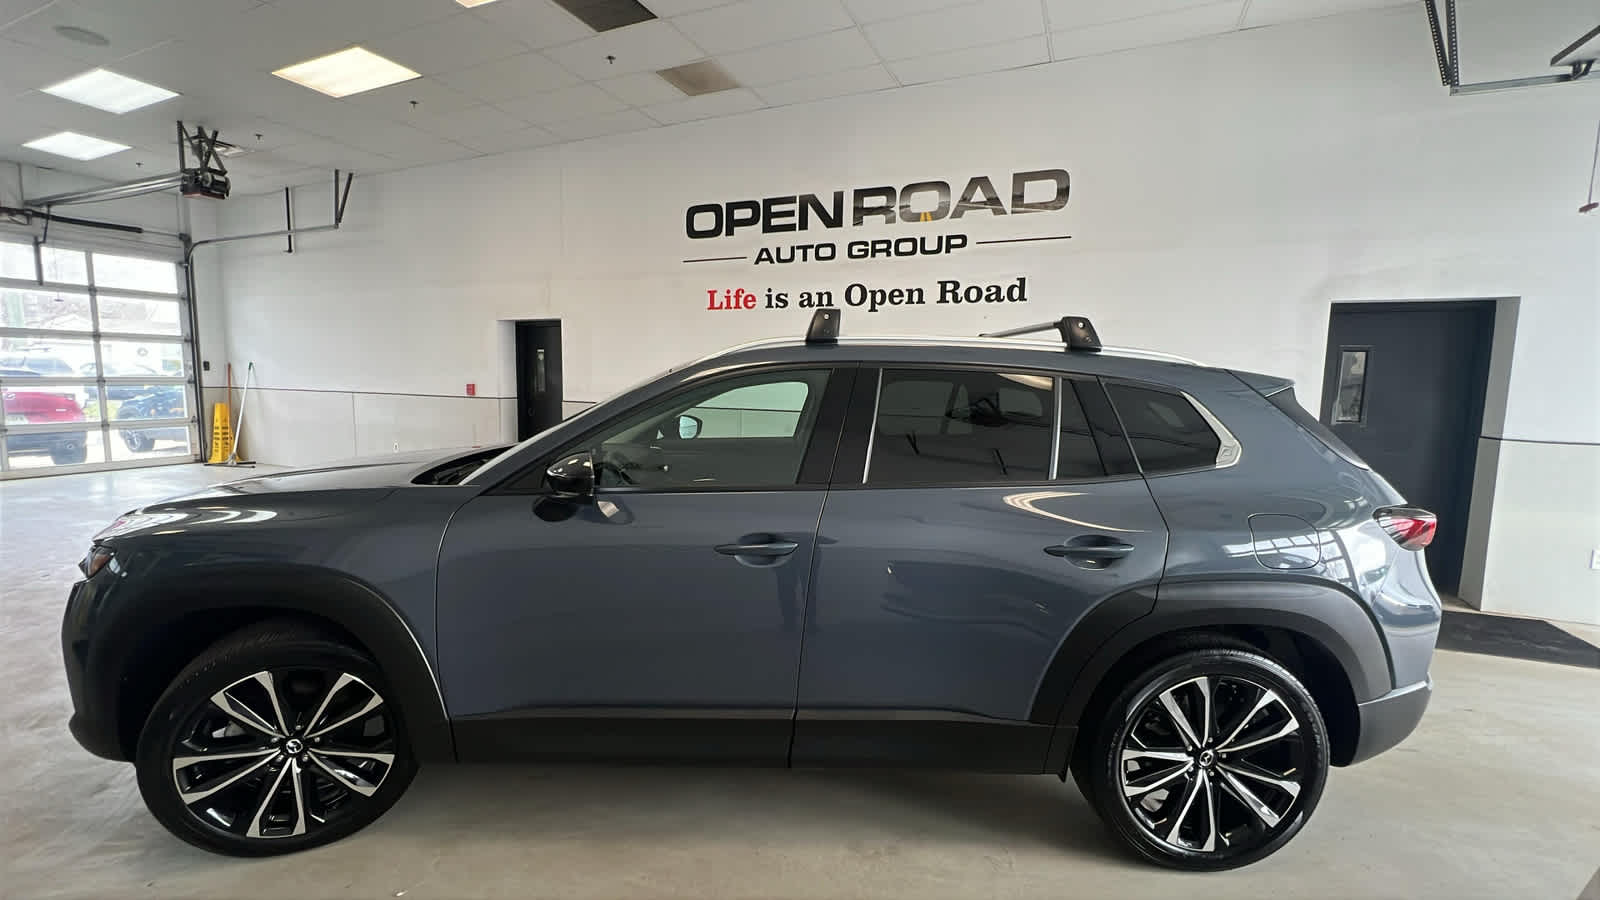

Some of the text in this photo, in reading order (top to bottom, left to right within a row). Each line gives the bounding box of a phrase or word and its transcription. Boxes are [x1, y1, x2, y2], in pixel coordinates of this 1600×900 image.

[686, 169, 1071, 239] OPEN ROAD
[754, 234, 967, 265] AUTO GROUP
[707, 277, 1028, 312] Life is an Open Road
